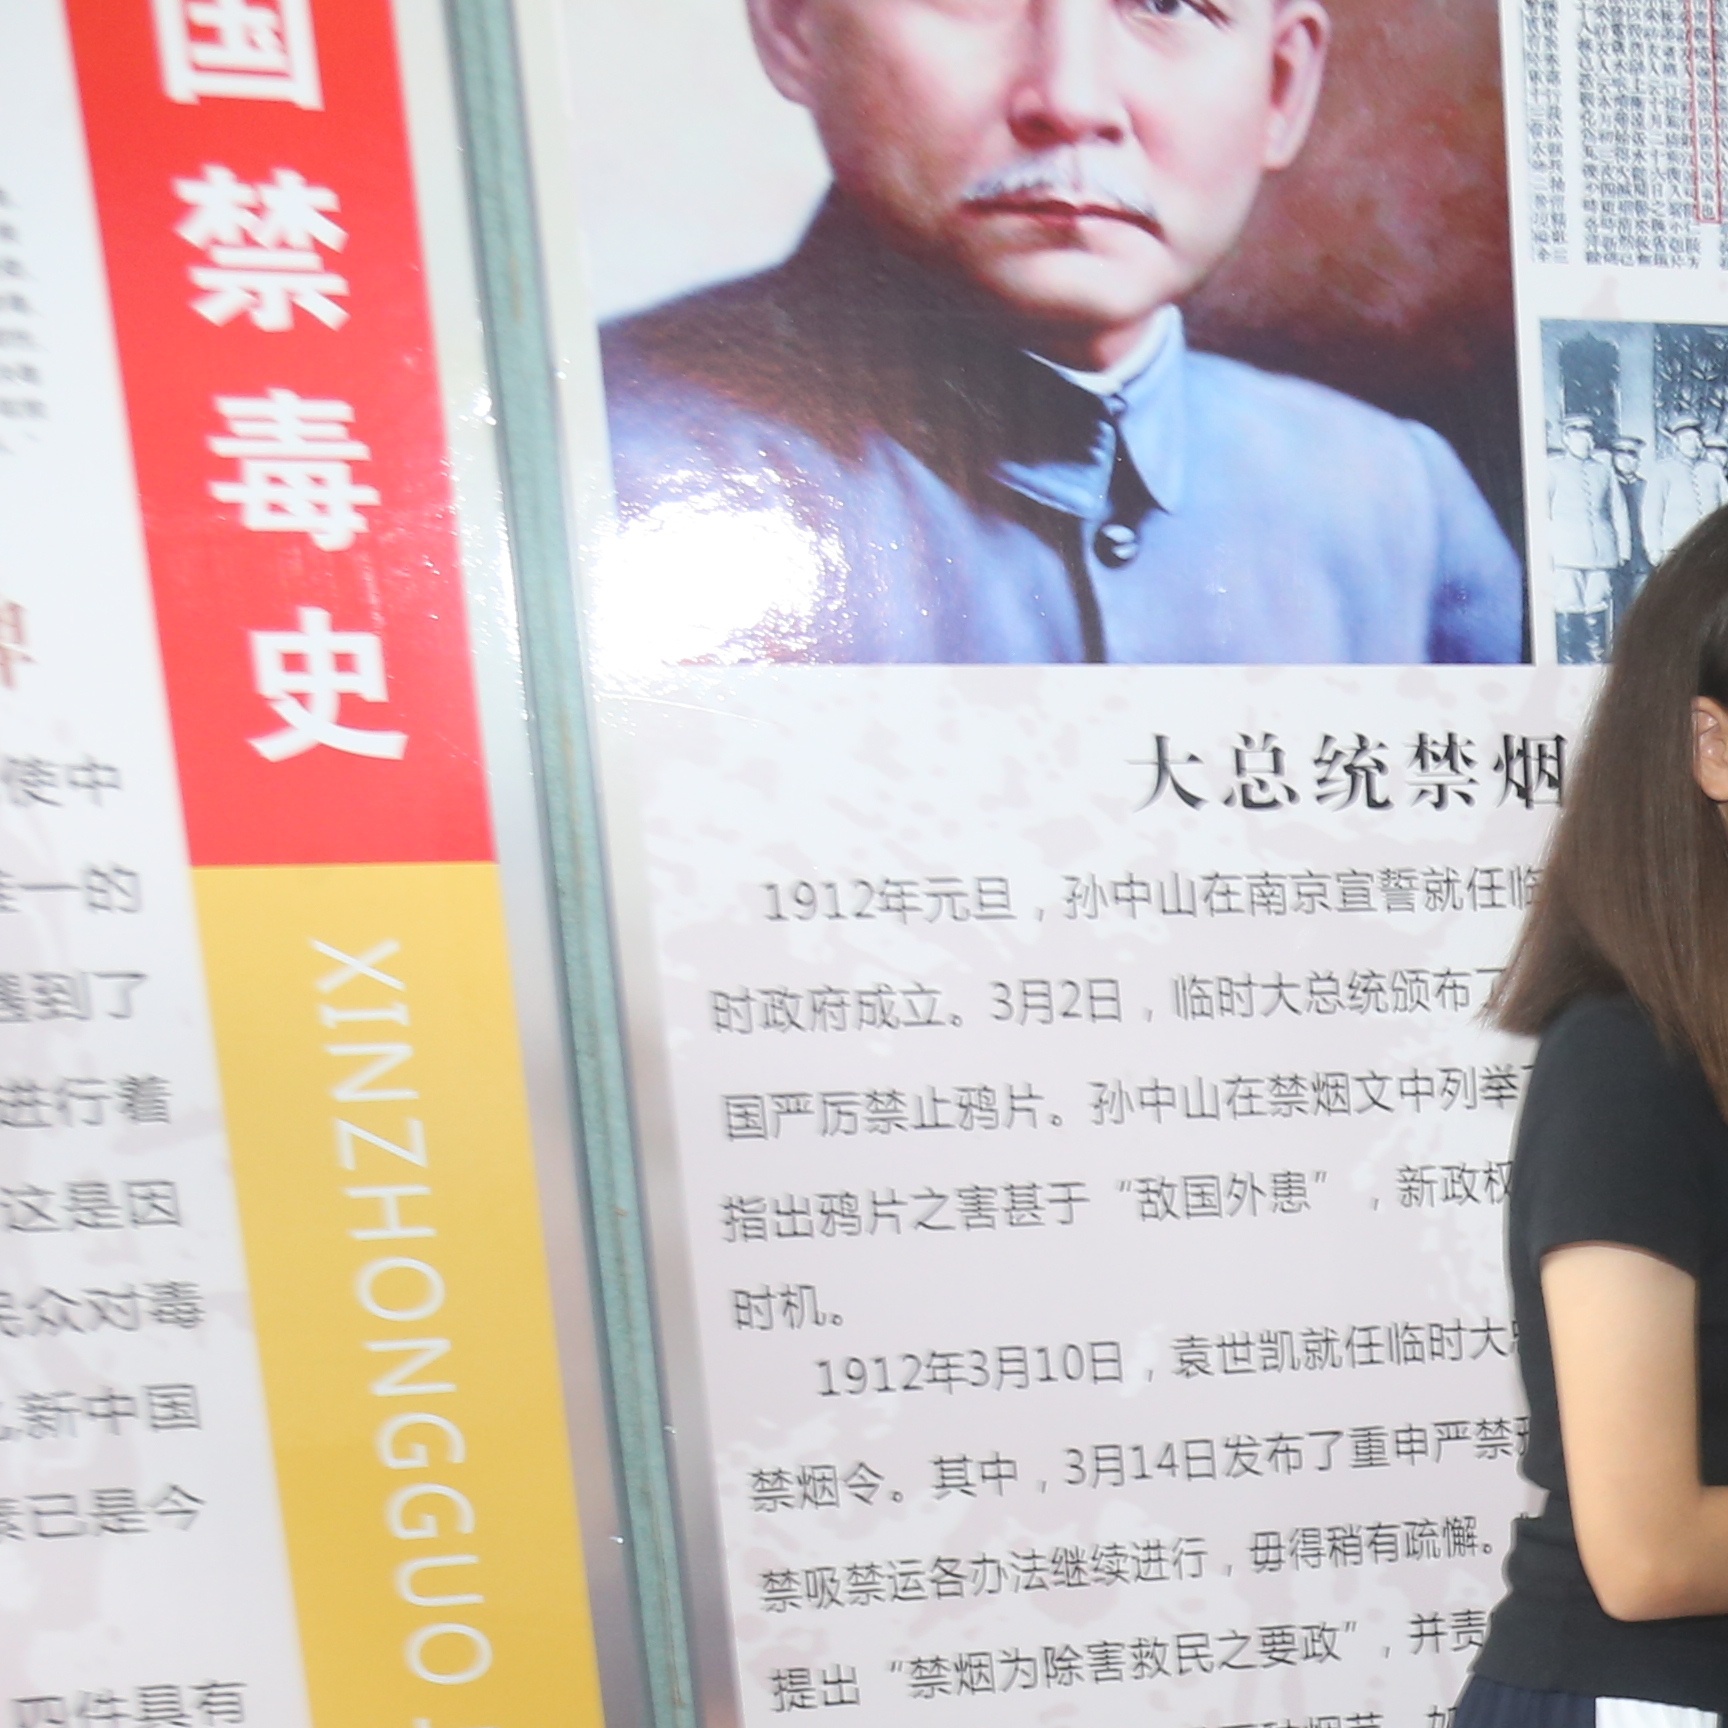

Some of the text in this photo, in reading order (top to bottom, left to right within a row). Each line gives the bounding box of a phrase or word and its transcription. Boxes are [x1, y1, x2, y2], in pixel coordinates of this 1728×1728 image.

[1127, 732, 1568, 812] 大总统禁烟
[0, 862, 145, 914] 一的
[721, 1065, 1534, 1142] 国严厉禁止鸦片。孙中山在禁烟文中列举
[309, 937, 494, 1687] XINZHONGGUO
[734, 1284, 845, 1331] 时机。
[816, 1316, 1519, 1397] 1912年3月10日，袁世凯就任临时大
